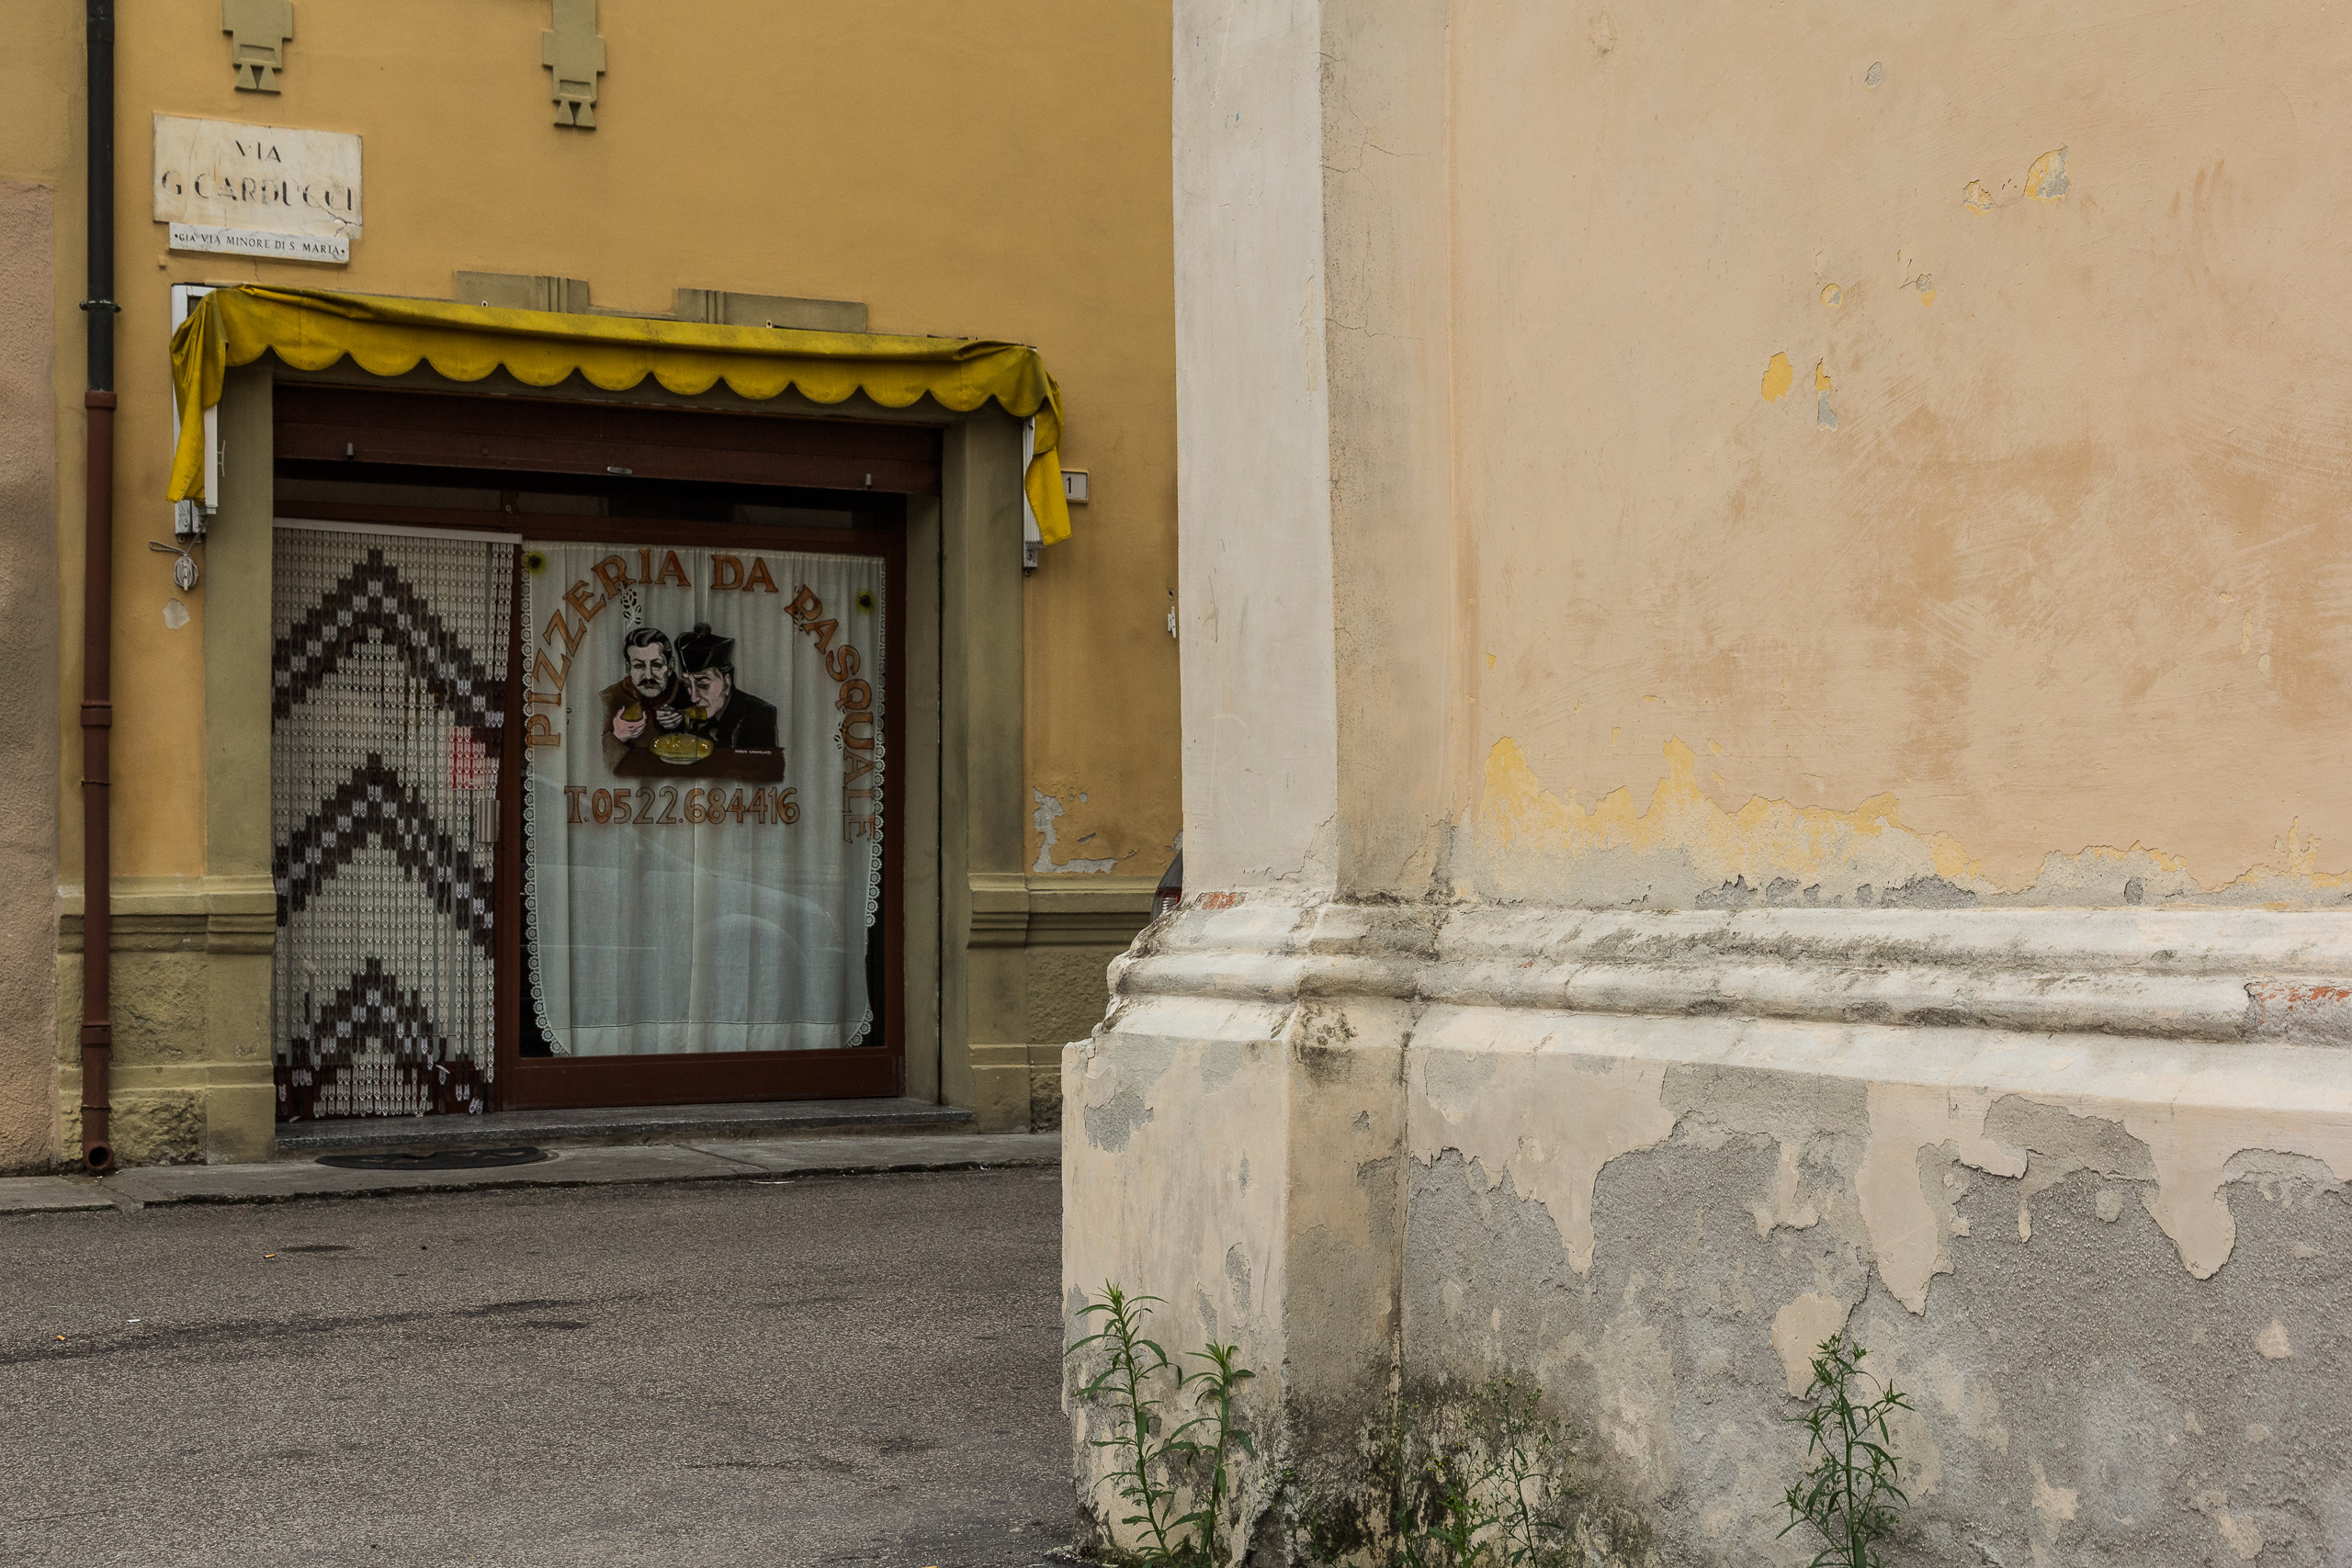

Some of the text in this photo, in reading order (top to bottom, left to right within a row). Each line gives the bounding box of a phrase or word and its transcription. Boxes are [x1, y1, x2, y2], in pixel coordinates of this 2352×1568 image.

[235, 140, 281, 163] VIA
[194, 173, 352, 210] CARDUCCI
[200, 233, 221, 245] VIA
[226, 236, 270, 249] MINORE
[275, 240, 285, 250] DI
[302, 243, 340, 255] MARIA
[526, 549, 876, 843] PIZZERIA DA PASQUALE
